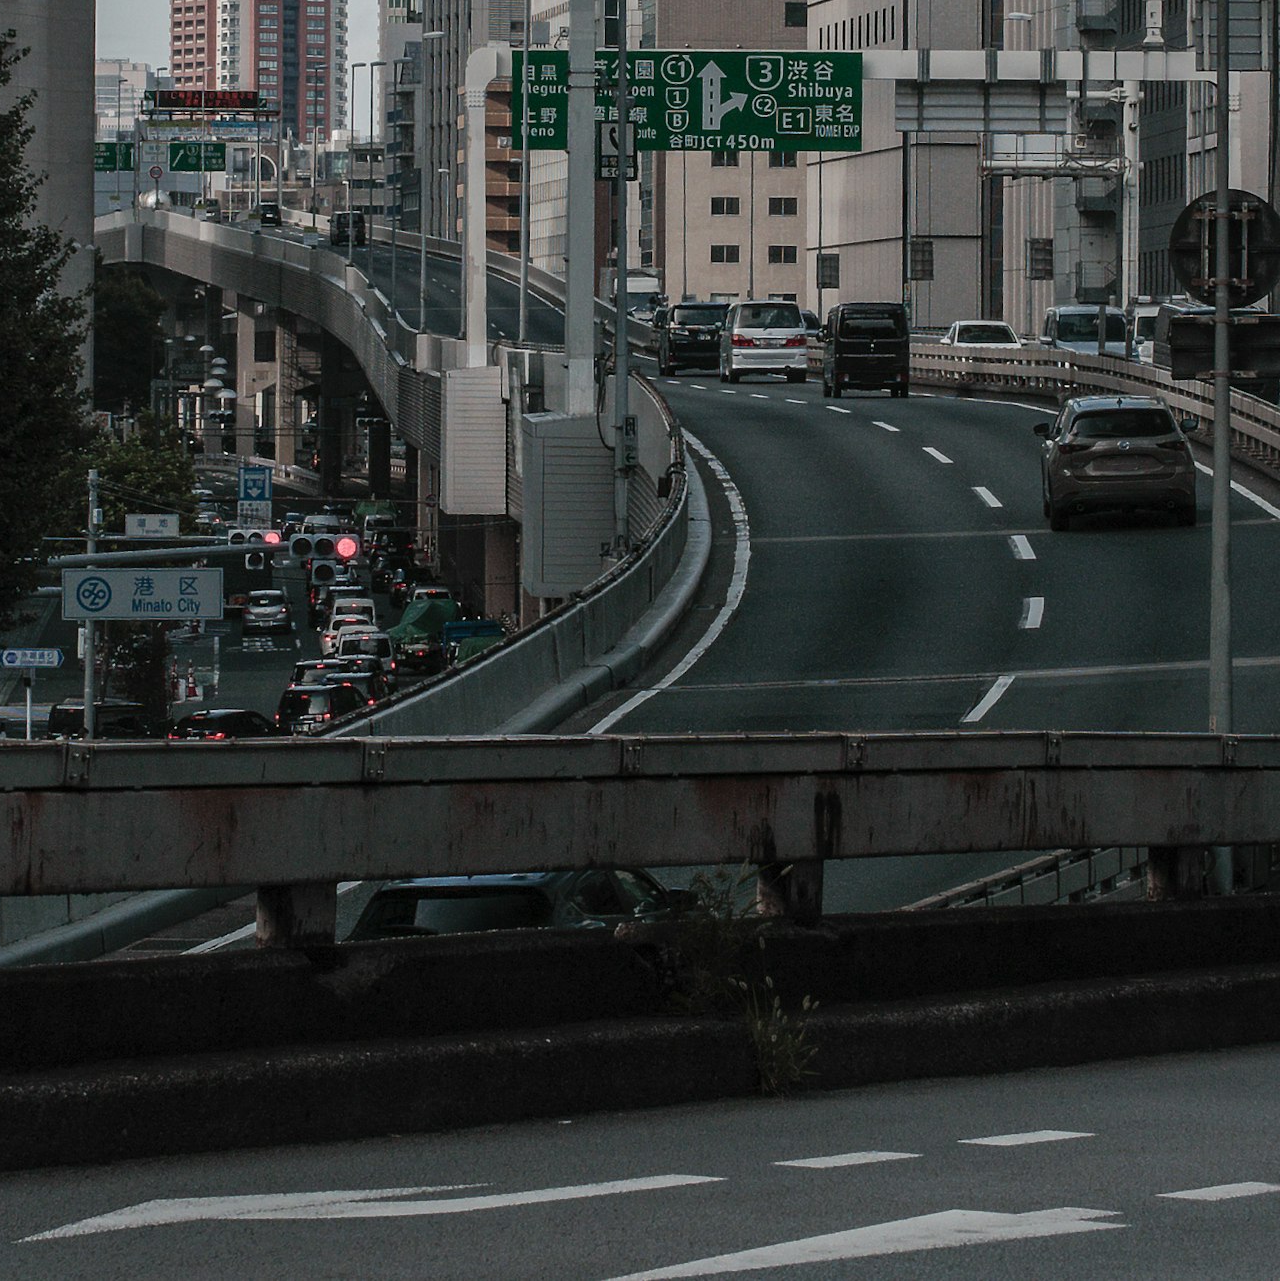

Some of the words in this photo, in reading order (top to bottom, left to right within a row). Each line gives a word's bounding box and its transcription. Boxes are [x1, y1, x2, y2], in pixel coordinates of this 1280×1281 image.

[521, 63, 558, 81] 目黒
[666, 60, 686, 78] C1
[759, 61, 773, 83] 3
[788, 60, 834, 81] 渋谷
[673, 91, 682, 104] 1
[788, 83, 853, 101] Shibuya
[521, 106, 557, 124] 上野
[755, 99, 773, 113] C2
[815, 104, 855, 123] 東名
[672, 114, 683, 127] B
[782, 112, 805, 129] E1
[815, 125, 842, 138] TOMEI
[844, 125, 860, 138] EXP
[669, 134, 722, 149] 谷町JCT
[726, 134, 775, 150] 450m
[134, 576, 199, 596] 港区
[132, 598, 172, 613] Minato
[178, 598, 201, 615] City
